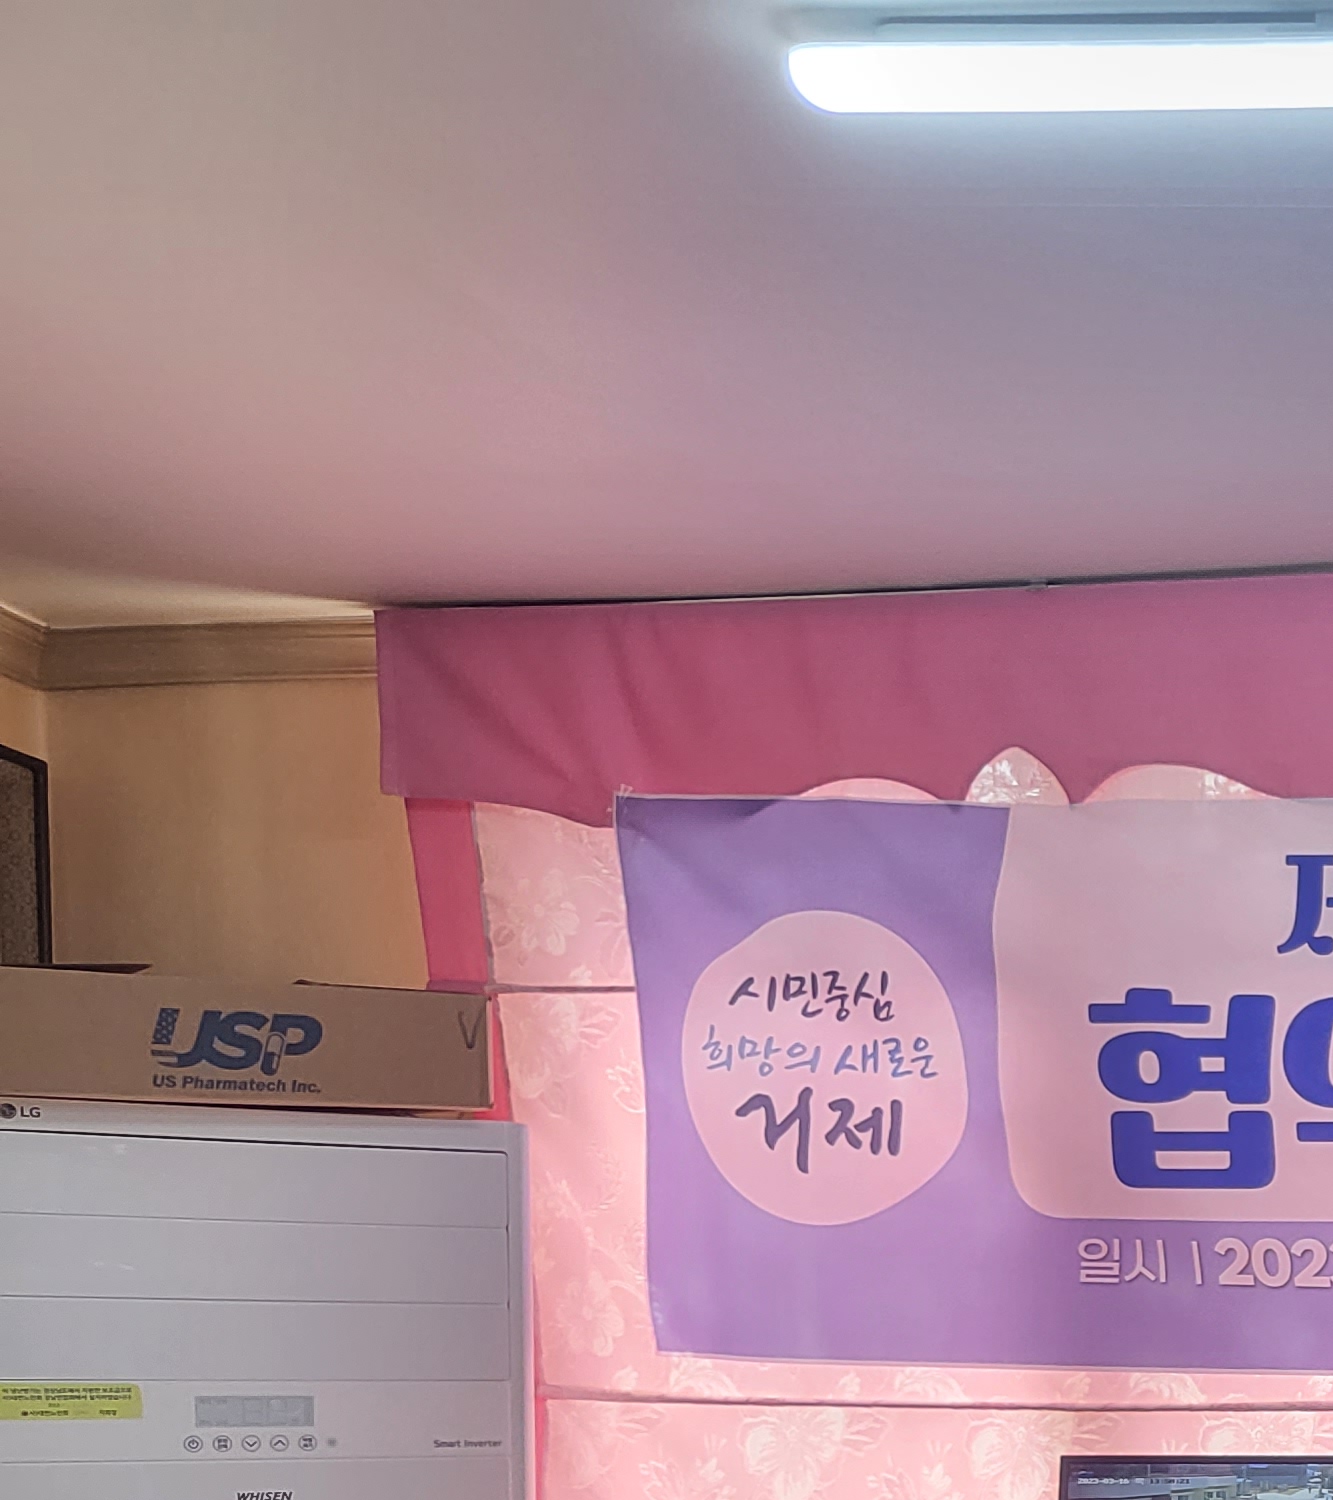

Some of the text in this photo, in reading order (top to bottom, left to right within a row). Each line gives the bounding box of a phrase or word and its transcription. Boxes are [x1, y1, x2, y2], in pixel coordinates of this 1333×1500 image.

[728, 970, 895, 1021] 시민중심
[702, 1026, 939, 1080] 희망의 새로운
[152, 1074, 321, 1093] US Pharmatech Inc.
[20, 1106, 41, 1118] LG
[735, 1087, 903, 1173] 거제
[1077, 1237, 1168, 1286] 일시
[433, 1438, 461, 1448] Smart
